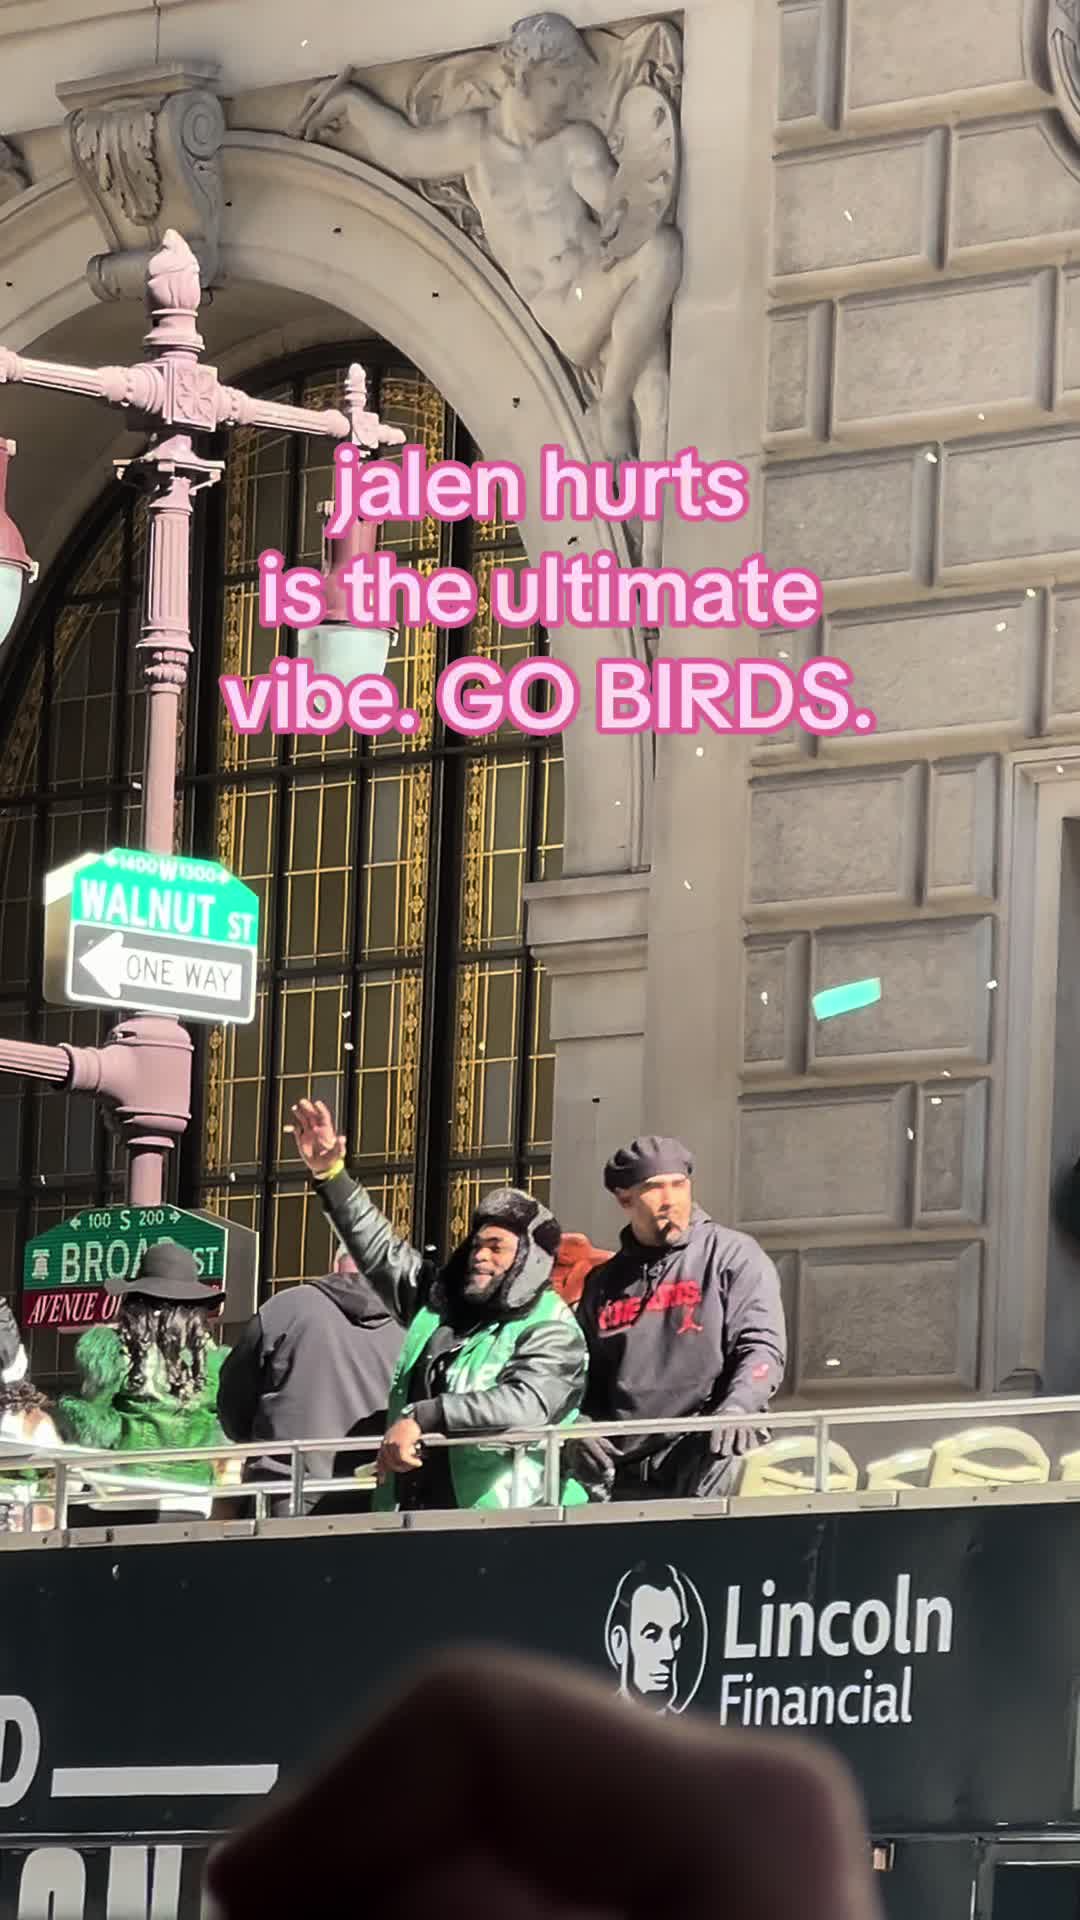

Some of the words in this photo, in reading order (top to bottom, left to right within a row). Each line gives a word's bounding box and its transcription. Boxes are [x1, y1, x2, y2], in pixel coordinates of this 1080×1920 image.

[119, 856, 157, 874] 1400
[159, 860, 178, 882] W
[80, 879, 216, 938] WALNUT
[228, 911, 255, 940] ST
[126, 954, 174, 985] ONE
[185, 963, 233, 993] WAY
[88, 1213, 111, 1229] 100
[119, 1210, 131, 1231] S
[139, 1210, 164, 1225] 200
[60, 1236, 175, 1285] BROA
[193, 1246, 219, 1276] ST
[28, 1292, 99, 1325] AVENUE
[723, 1573, 954, 1659] Lincoln
[719, 1666, 912, 1726] Financial
